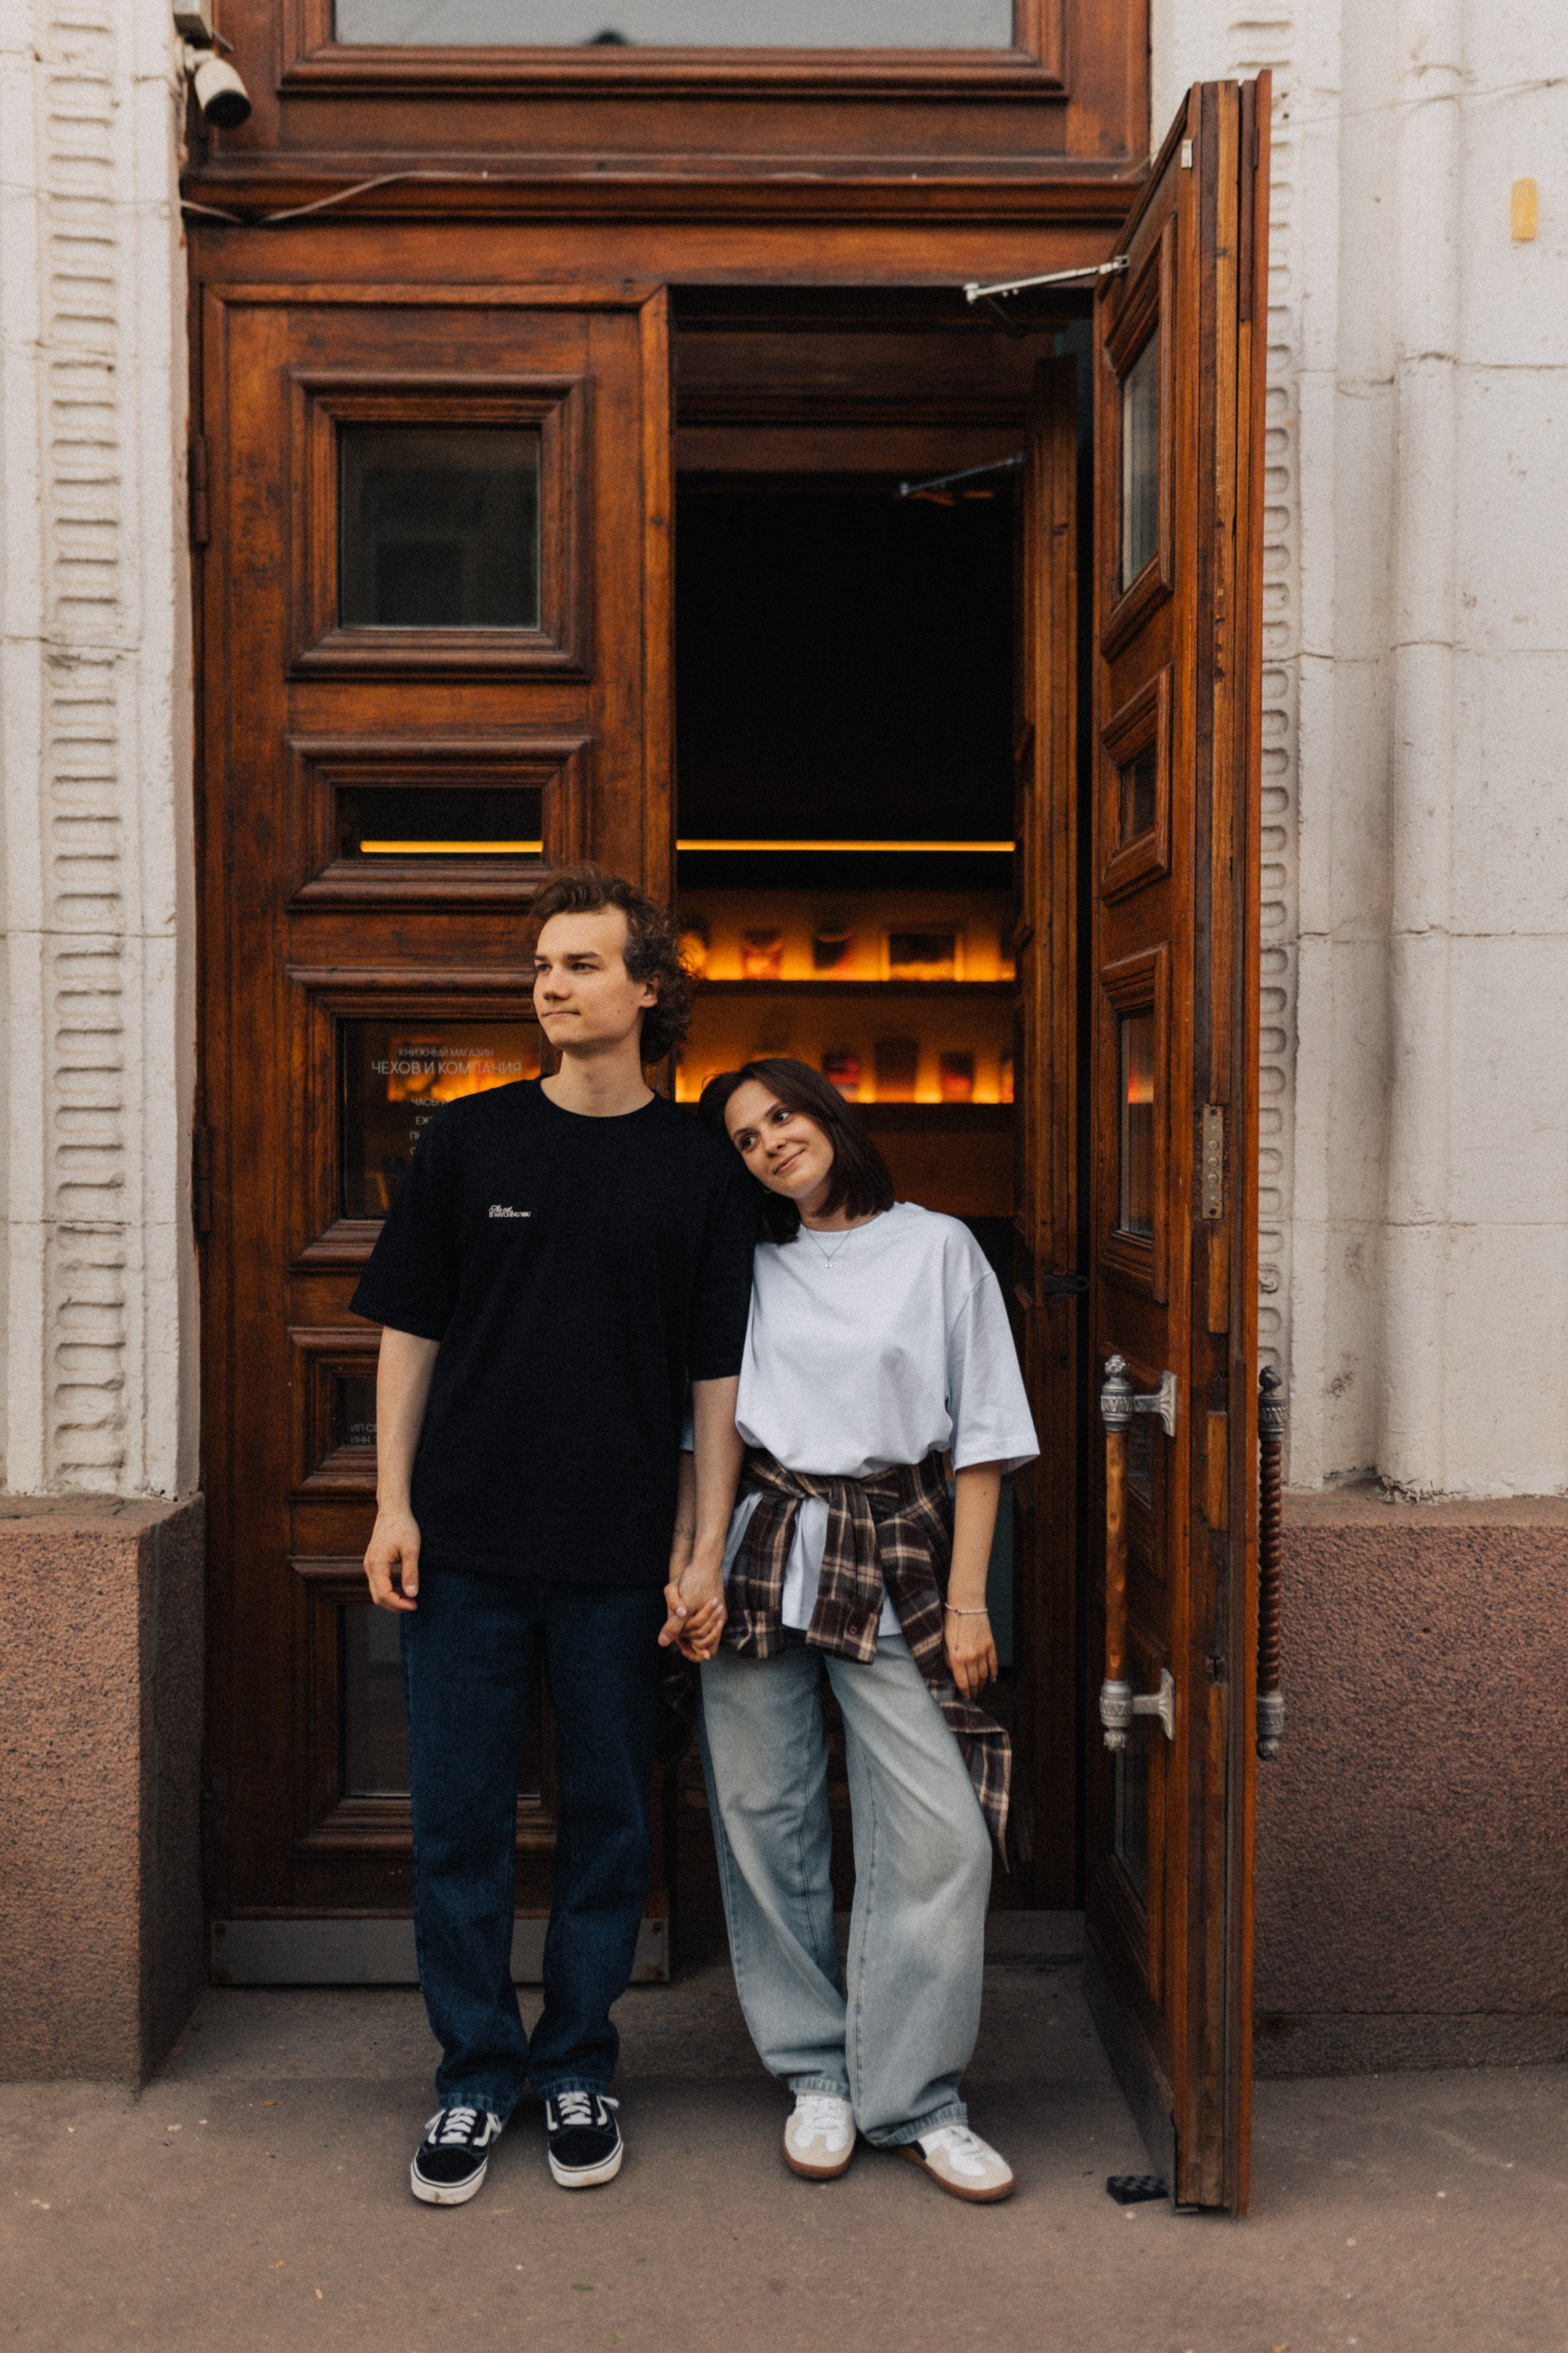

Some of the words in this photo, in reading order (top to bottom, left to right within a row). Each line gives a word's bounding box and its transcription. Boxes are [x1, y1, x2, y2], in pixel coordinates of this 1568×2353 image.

[399, 1047, 448, 1057] КНИЖНЫЙ
[450, 1048, 494, 1057] МАГАЗИН
[372, 1061, 421, 1075] ЧЕХОВ
[424, 1061, 434, 1075] И
[438, 1061, 522, 1075] КОМПАНИЯ
[411, 1098, 440, 1107] ЧАСЫ
